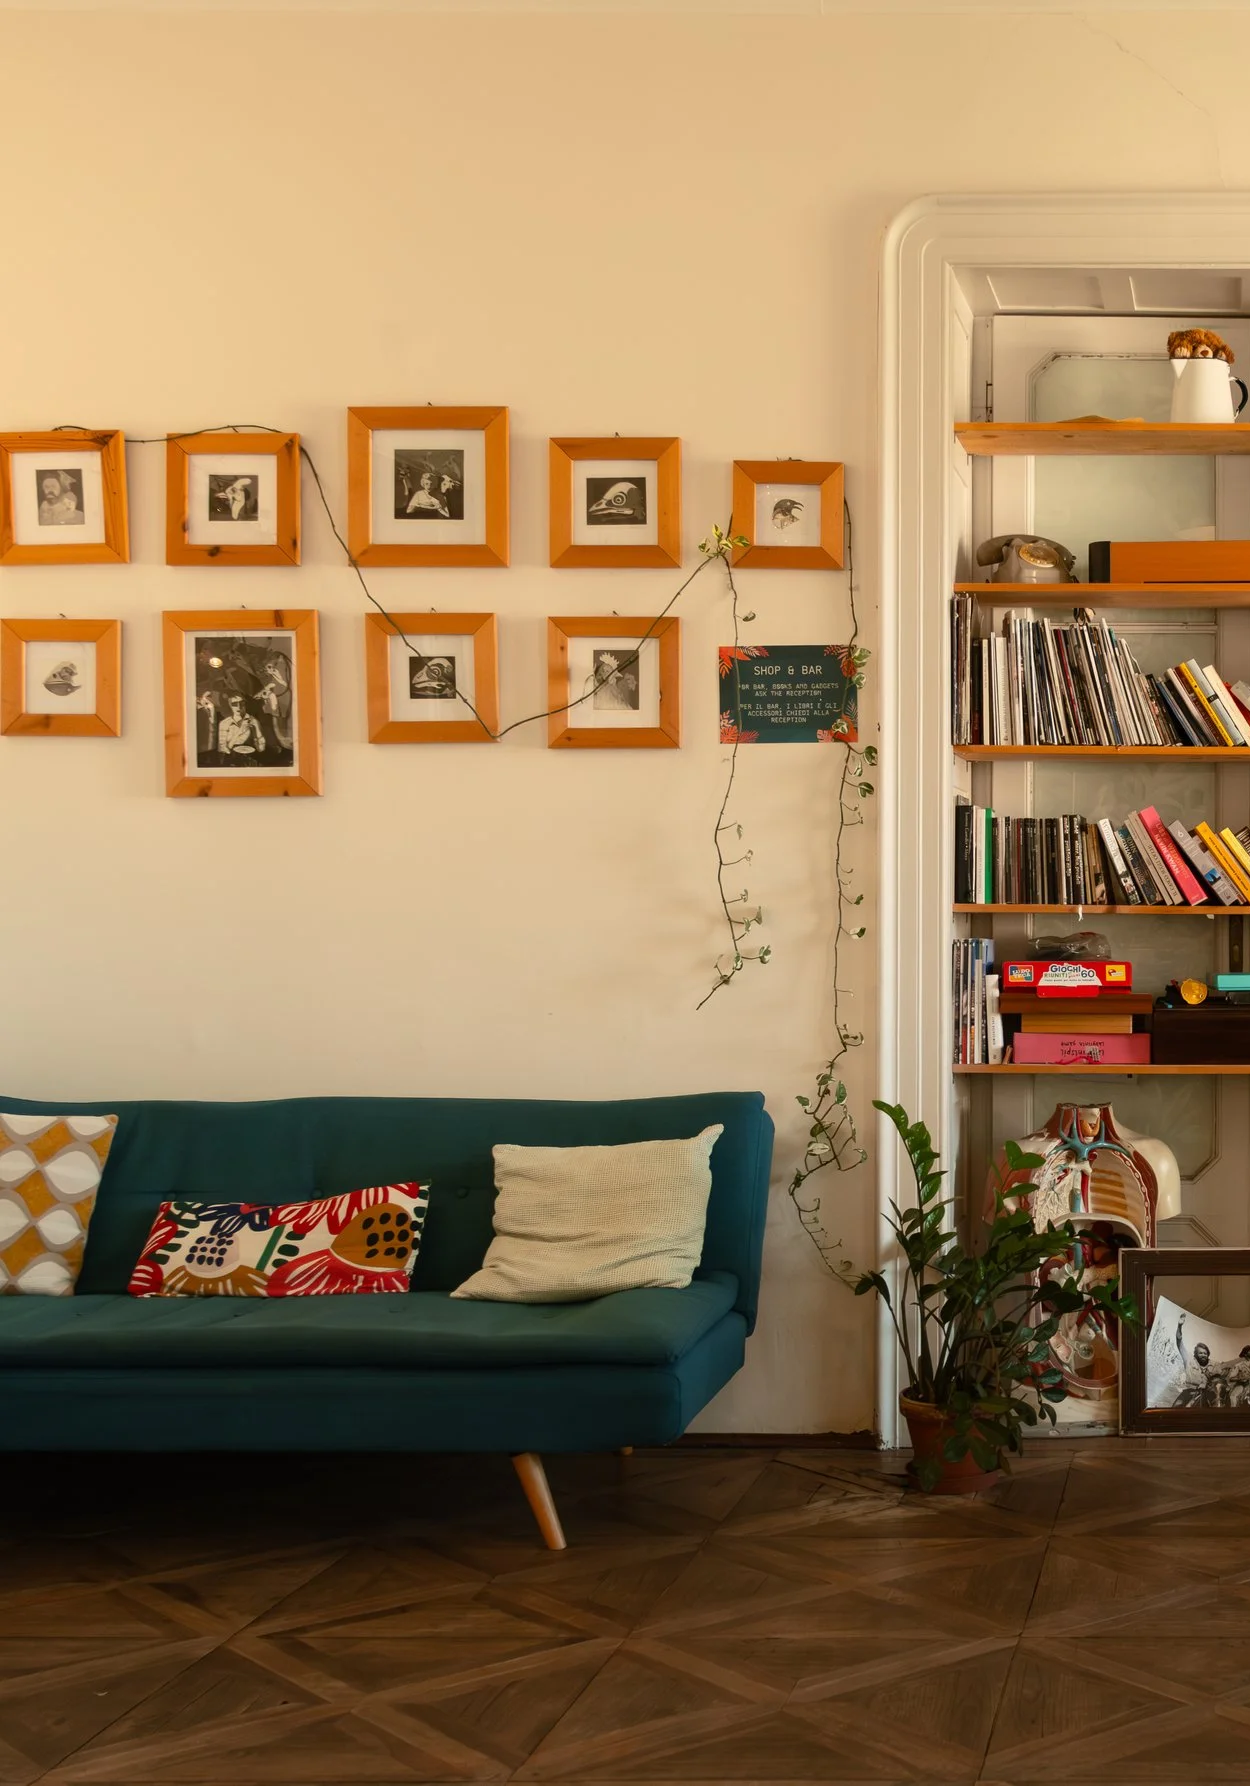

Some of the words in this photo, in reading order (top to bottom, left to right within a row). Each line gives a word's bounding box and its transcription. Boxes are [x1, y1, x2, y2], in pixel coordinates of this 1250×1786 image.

[753, 665, 781, 676] SHOP
[787, 665, 795, 675] &
[801, 665, 823, 675] BAR
[1164, 852, 1180, 875] KWAN
[1050, 965, 1081, 973] GIOCHI
[1080, 969, 1095, 978] 60
